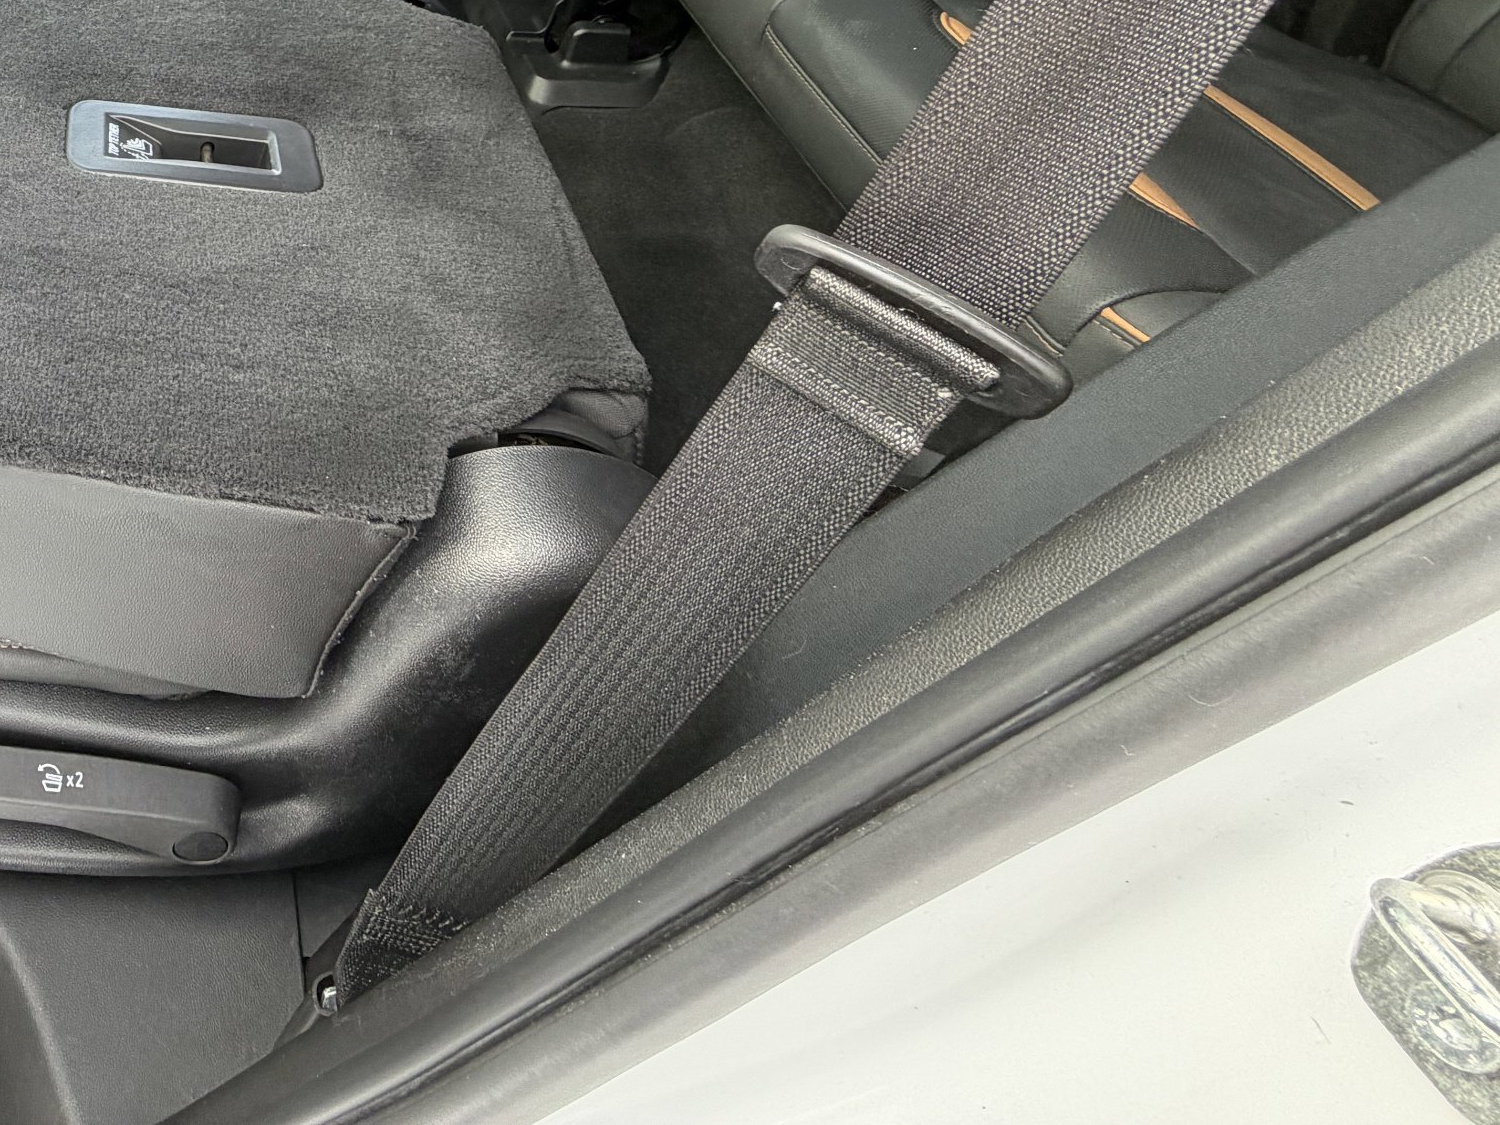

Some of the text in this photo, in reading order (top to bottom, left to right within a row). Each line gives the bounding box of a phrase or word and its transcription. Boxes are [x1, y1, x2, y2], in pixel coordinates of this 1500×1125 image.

[108, 122, 120, 156] TOP TETHER
[66, 771, 84, 788] x2
